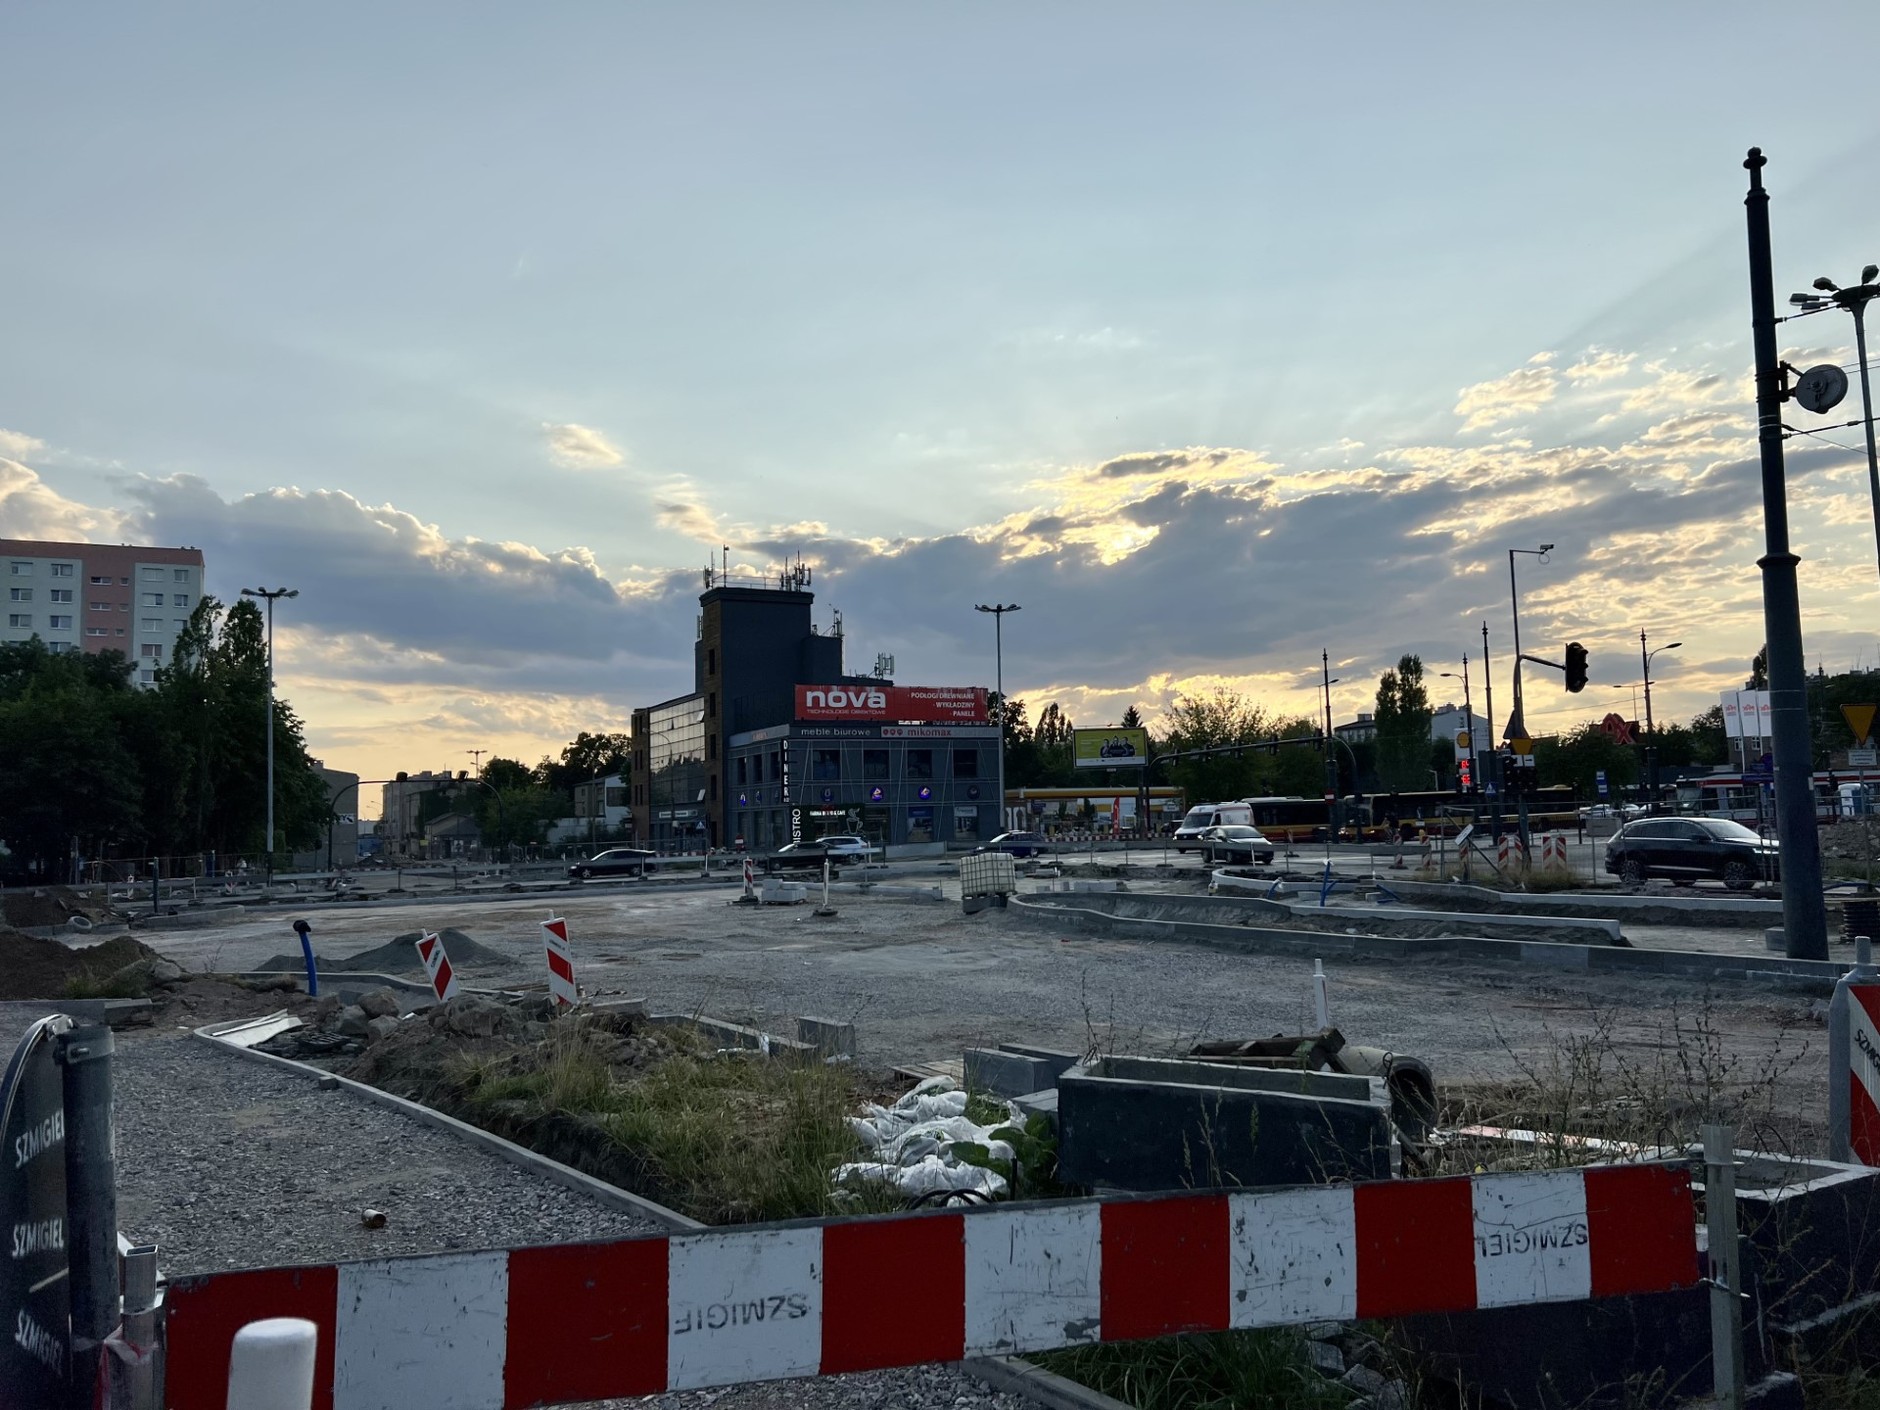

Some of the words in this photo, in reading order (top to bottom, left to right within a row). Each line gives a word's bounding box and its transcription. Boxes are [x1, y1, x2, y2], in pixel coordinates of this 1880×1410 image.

[806, 690, 886, 708] nova
[801, 728, 830, 736] meble
[834, 728, 871, 736] biurowe
[907, 727, 951, 737] mikomax
[12, 1218, 64, 1259] SZMIGIEL
